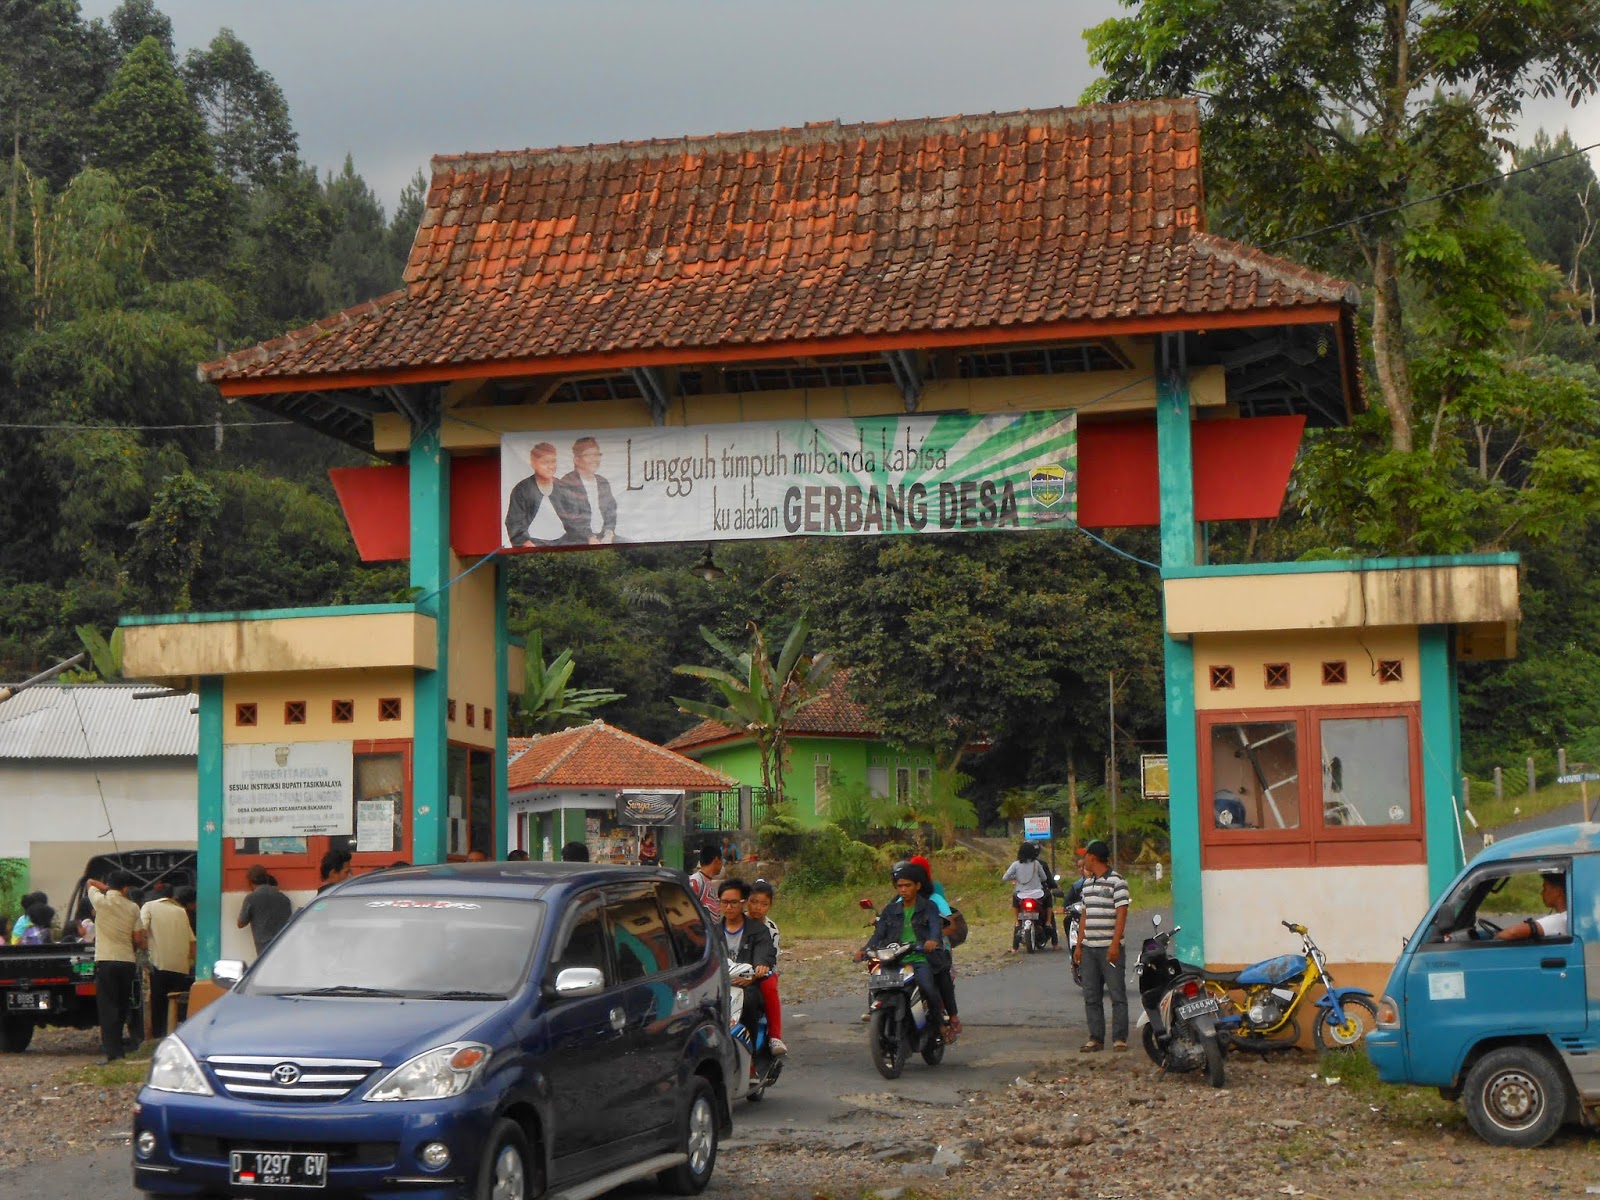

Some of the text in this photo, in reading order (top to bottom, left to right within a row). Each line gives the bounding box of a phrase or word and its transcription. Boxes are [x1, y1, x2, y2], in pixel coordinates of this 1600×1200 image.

[625, 425, 947, 498] Lungguh timpuh mibanda kabisa
[712, 479, 1021, 535] ku alatan GERBANG DESA
[250, 783, 281, 791] INSTRUKSI
[282, 781, 302, 789] BUPATI
[304, 780, 342, 789] TASIKMALAYA
[232, 1153, 324, 1176] D 1297 GV
